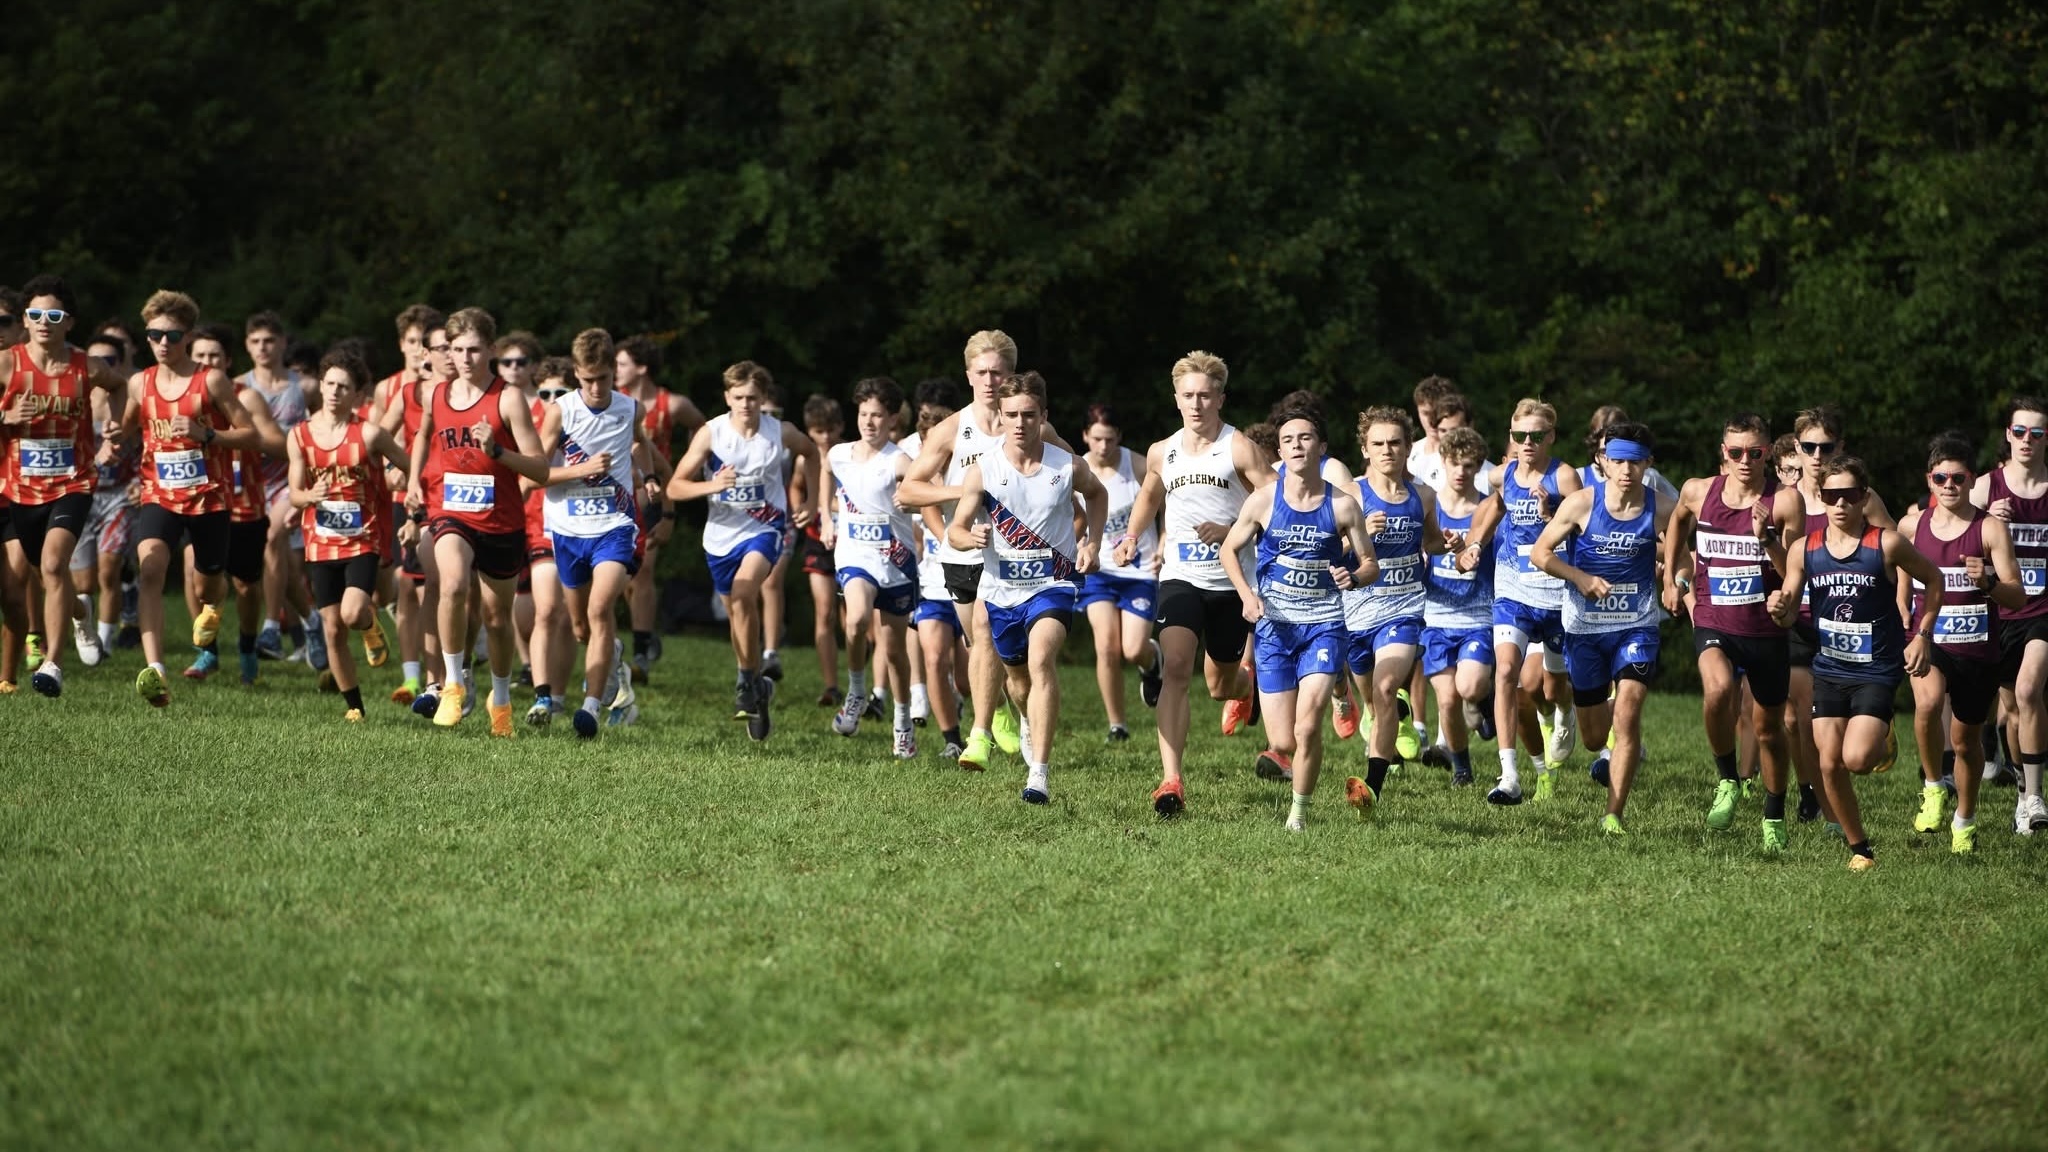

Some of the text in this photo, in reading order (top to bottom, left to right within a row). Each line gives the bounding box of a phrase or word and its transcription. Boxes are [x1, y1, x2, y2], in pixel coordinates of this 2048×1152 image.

[28, 451, 66, 467] 251
[163, 462, 197, 480] 250
[450, 485, 486, 503] 279
[726, 487, 758, 501] 361
[574, 498, 609, 516] 363
[323, 511, 354, 528] 249
[852, 525, 883, 541] 360
[1288, 524, 1318, 543] XC
[1607, 531, 1636, 550] XC
[1186, 542, 1221, 561] 299
[1007, 561, 1046, 579] 362
[1282, 570, 1319, 588] 405
[1383, 566, 1414, 585] 402
[1718, 578, 1753, 595] 427
[1812, 573, 1876, 588] NANTICOKE
[1829, 585, 1858, 597] AREA
[1595, 595, 1629, 611] 406
[1942, 617, 1979, 633] 429
[1828, 632, 1863, 652] 139
